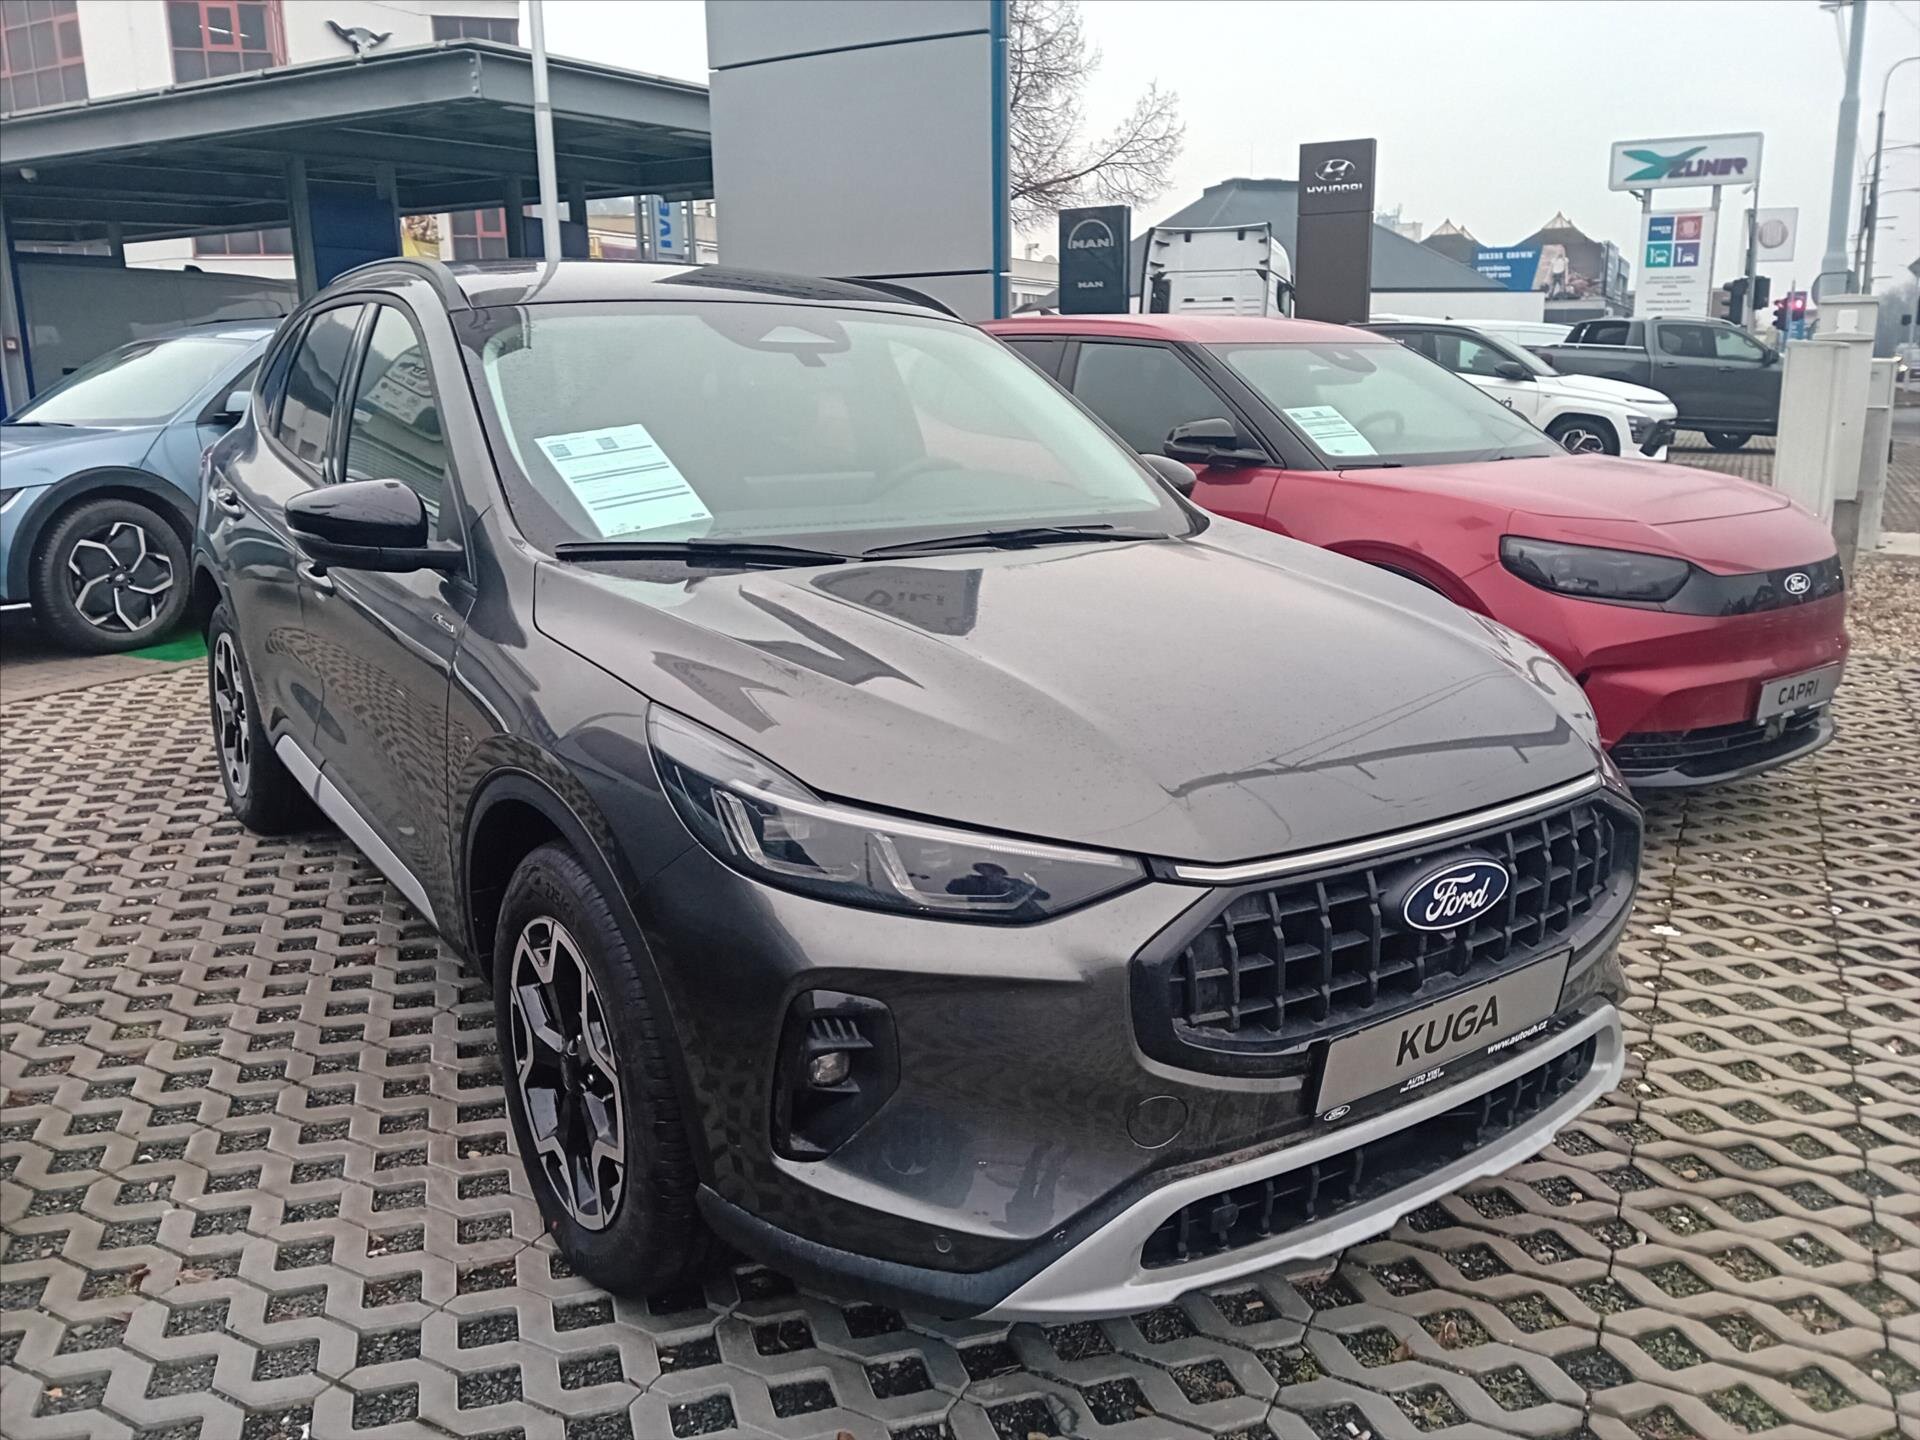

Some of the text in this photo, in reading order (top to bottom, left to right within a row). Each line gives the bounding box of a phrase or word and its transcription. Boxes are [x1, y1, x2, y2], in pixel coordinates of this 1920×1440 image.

[1071, 238, 1110, 249] MAN
[1778, 678, 1820, 705] CAPRI
[1425, 872, 1491, 922] Ford
[1396, 995, 1498, 1067] KUGA
